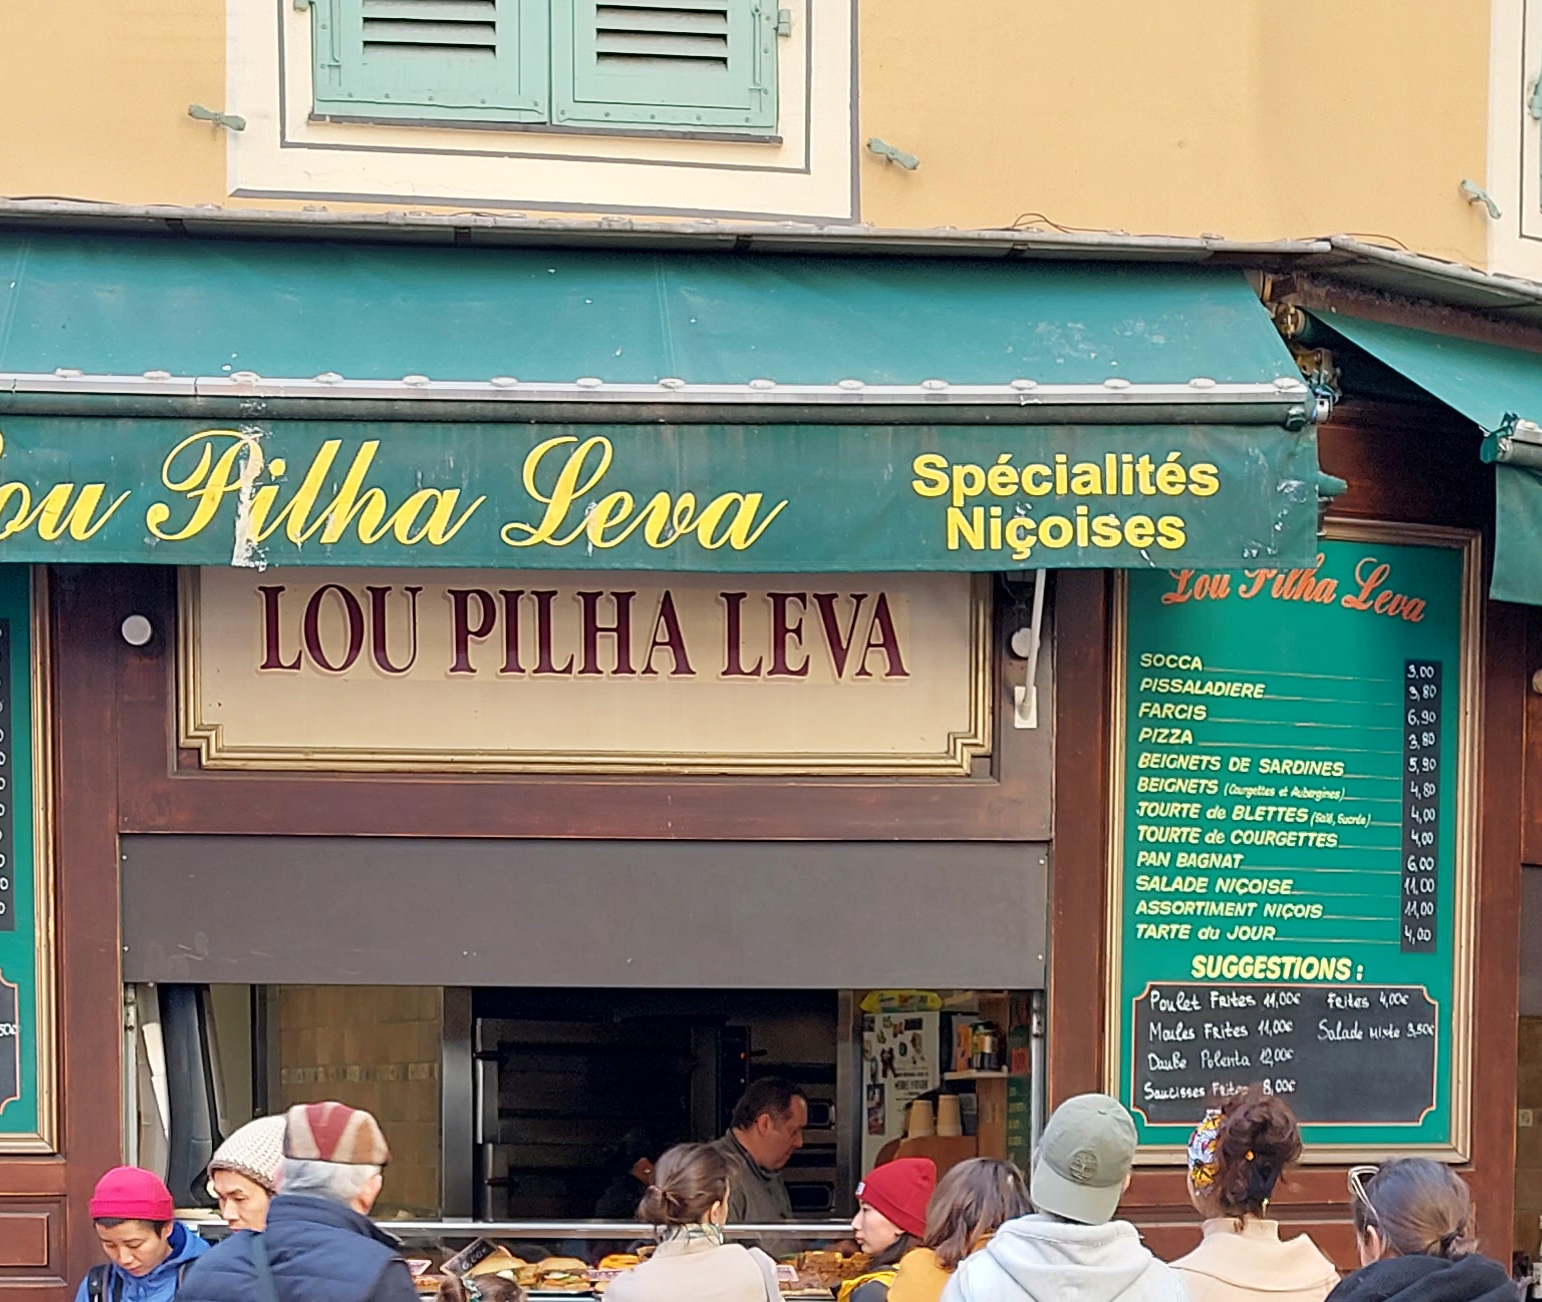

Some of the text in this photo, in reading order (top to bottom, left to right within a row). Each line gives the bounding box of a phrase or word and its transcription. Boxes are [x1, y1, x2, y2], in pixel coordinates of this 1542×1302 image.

[911, 451, 1220, 502] Spécialités
[148, 428, 485, 546] Pilha
[501, 435, 788, 550] Leva
[946, 506, 1187, 561] Niçoises
[1341, 557, 1426, 623] Leva
[257, 583, 911, 681] LOU PILHA LEVA
[1139, 653, 1203, 671] SOCCA
[1139, 677, 1266, 699] PISSALADIERE
[1138, 702, 1207, 720] FARCIS
[1138, 727, 1193, 744] PIZZA
[1137, 752, 1222, 770] BEIGNETS
[1228, 756, 1252, 773] DE
[1258, 758, 1345, 777] SARDINES
[1136, 776, 1219, 794] BEIGNETS
[1136, 801, 1202, 819] TOURTE
[1206, 805, 1227, 820] de
[1231, 805, 1309, 823] BLETTES
[1137, 825, 1202, 843] TOURTE
[1204, 829, 1226, 844] de
[1230, 829, 1338, 848] COURGETTES
[1137, 851, 1171, 867] PAN
[1176, 852, 1244, 869] BAGNAT
[1135, 875, 1209, 893] SALADE
[1215, 877, 1294, 896] NIÇOISE
[1135, 900, 1258, 917] ASSORTIMENT
[1263, 903, 1323, 920] NIÇOIS
[1136, 924, 1192, 940] TARTE
[1198, 926, 1220, 940] du
[1227, 926, 1276, 941] JOUR
[1150, 990, 1202, 1013] Poulet
[1148, 1021, 1196, 1042] Moules
[1201, 1049, 1251, 1069] Polenta
